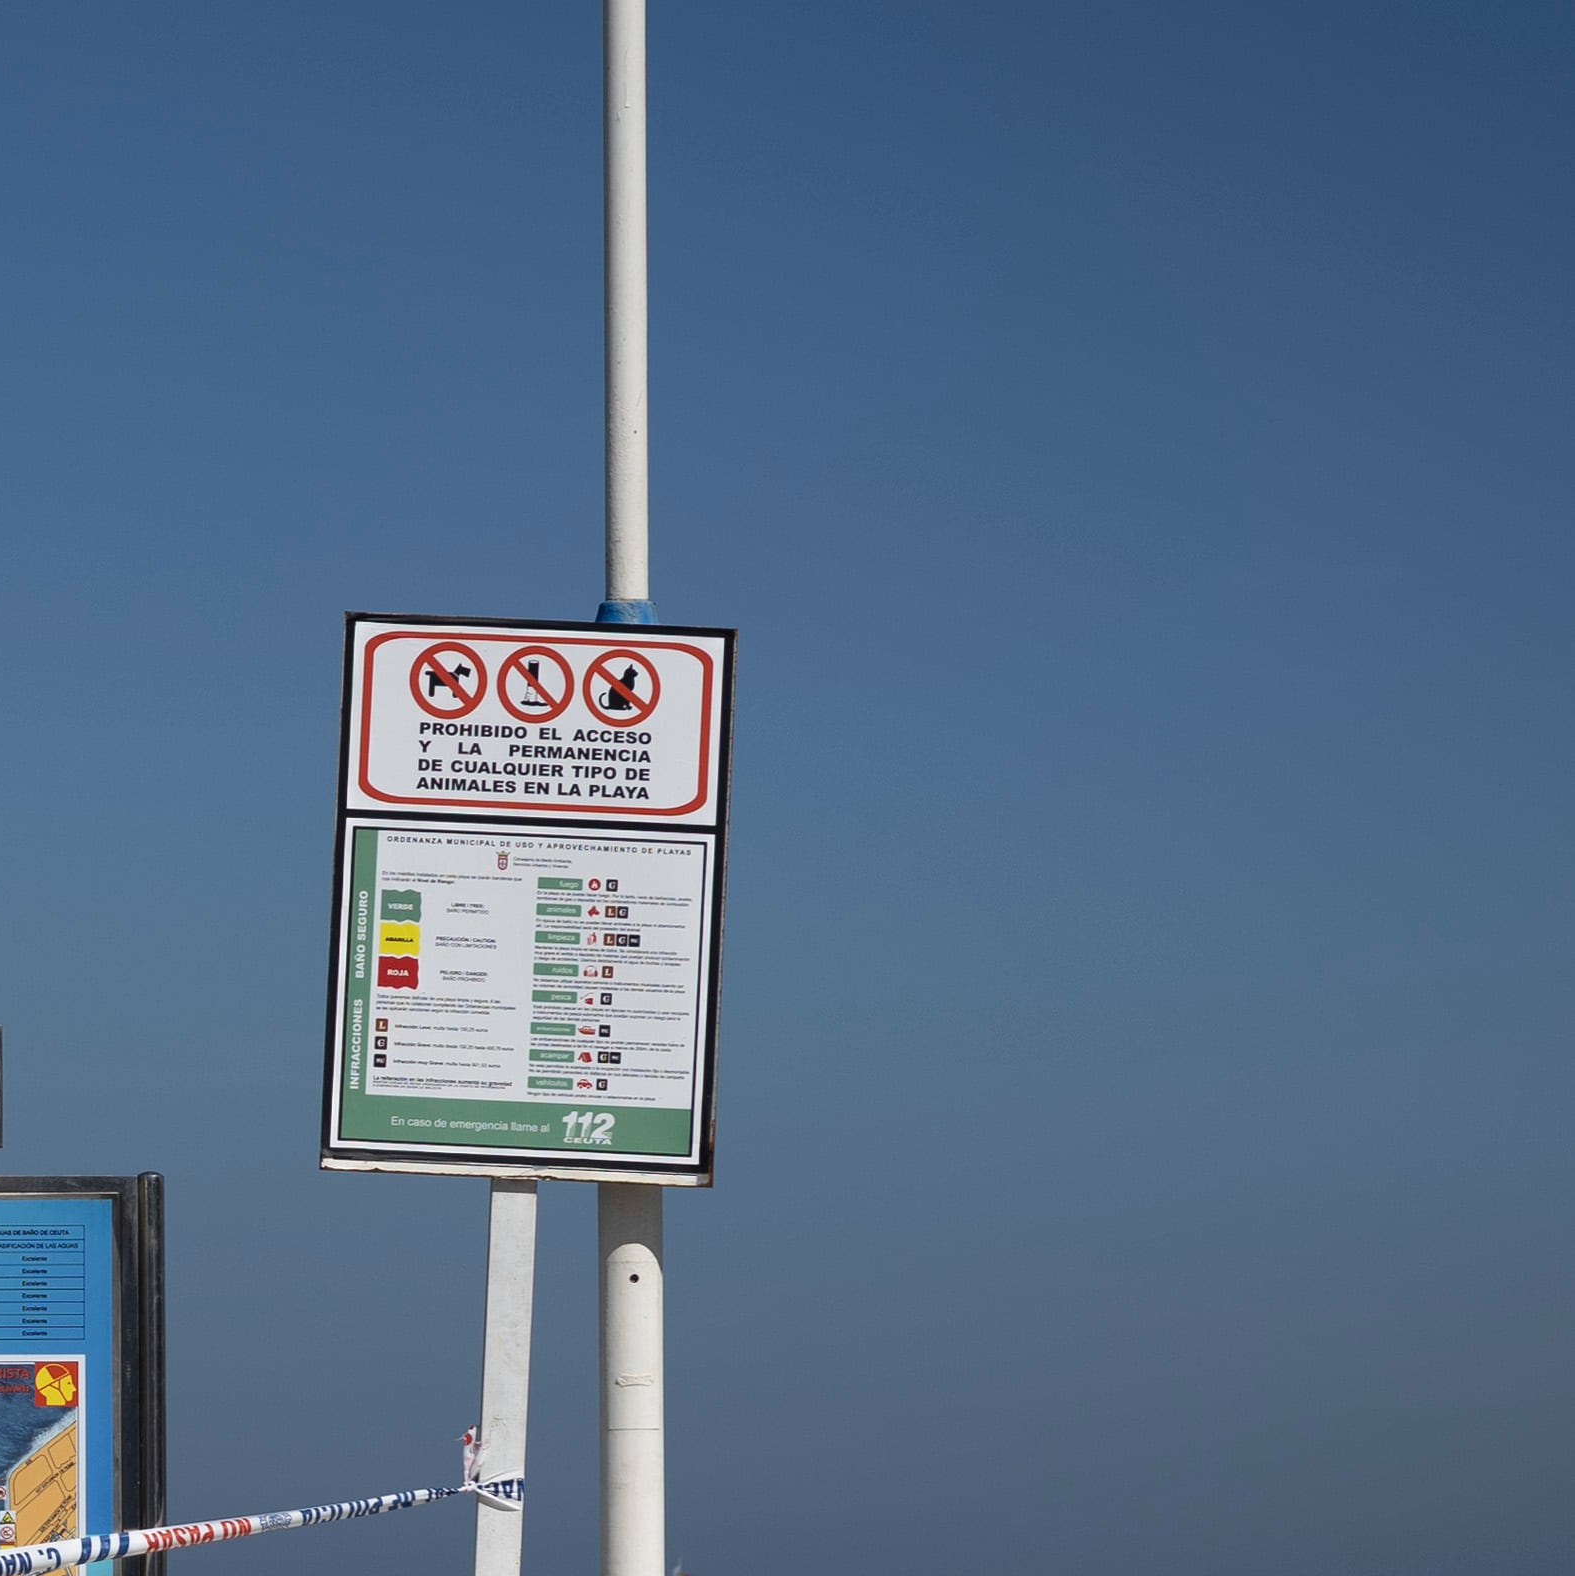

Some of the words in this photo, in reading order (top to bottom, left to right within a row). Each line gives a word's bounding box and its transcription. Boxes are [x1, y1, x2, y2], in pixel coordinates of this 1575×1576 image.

[419, 721, 527, 739] PROHIBIDO
[539, 727, 561, 740] EL
[572, 728, 651, 744] ACCESO
[418, 739, 431, 753] Y
[457, 741, 482, 755] LA
[508, 744, 651, 762] PERMANENCIA
[418, 758, 442, 772] DE
[450, 759, 563, 777] CUALQUIER
[571, 764, 616, 780] TIPO
[625, 767, 649, 781] DE
[416, 776, 516, 793] ANIMALES
[523, 780, 549, 795] EN
[557, 782, 581, 796] LA
[588, 784, 649, 799] PLAYA
[386, 835, 442, 844] ORDENANZA
[446, 838, 495, 847] MUNICIPAL
[546, 842, 637, 853] APROVECHAMIENTO
[641, 846, 652, 854] DE
[656, 847, 691, 856] PLAYAS
[357, 890, 369, 941] SEGURO
[387, 902, 413, 910] VERDE
[355, 944, 366, 979] BAÑO
[386, 968, 409, 976] ROJA
[350, 999, 363, 1089] INFRACCIONES
[390, 1115, 405, 1126] En
[406, 1118, 432, 1127] caso
[433, 1117, 447, 1128] de
[449, 1120, 508, 1132] emergencia
[510, 1121, 538, 1132] llame
[540, 1123, 549, 1133] al
[562, 1110, 615, 1138] 112
[563, 1134, 611, 1144] CEUTA
